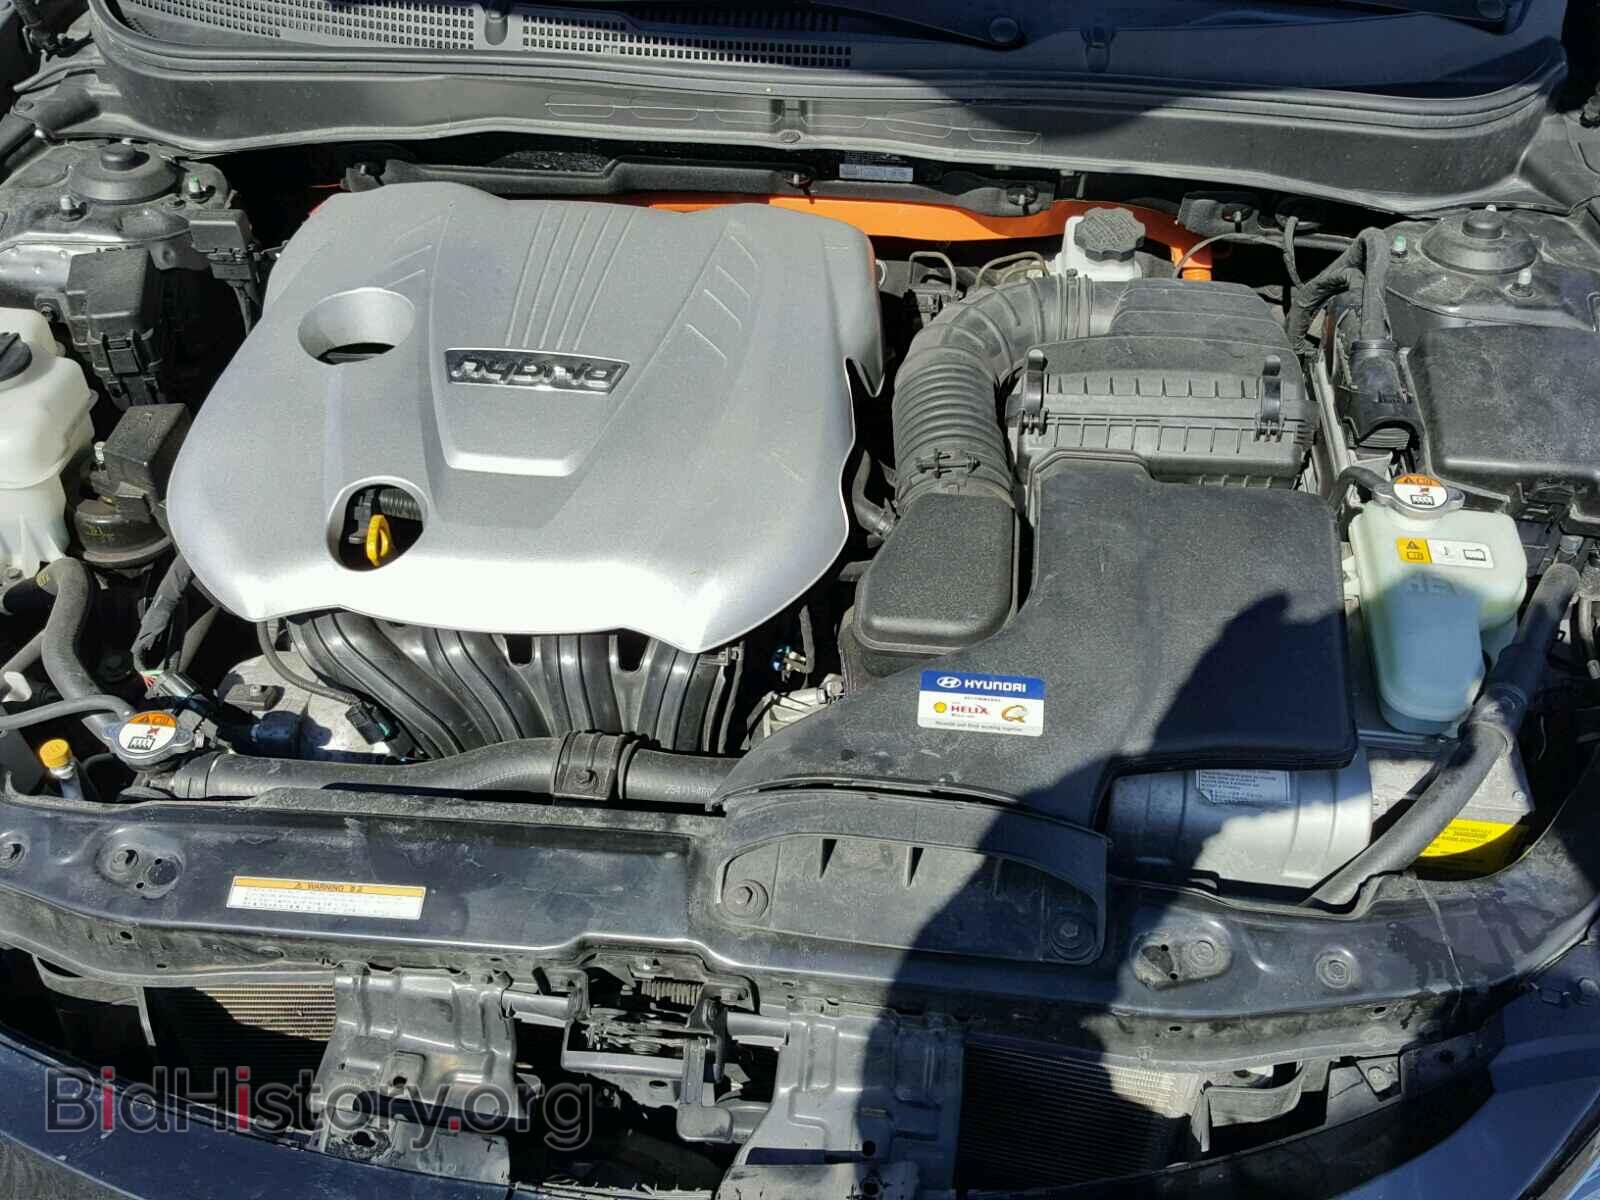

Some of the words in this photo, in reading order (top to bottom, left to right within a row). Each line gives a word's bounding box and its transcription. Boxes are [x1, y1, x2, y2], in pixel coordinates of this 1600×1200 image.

[964, 679, 1026, 692] HYUNDAI
[951, 703, 989, 716] HELIX
[308, 881, 344, 892] WARNING
